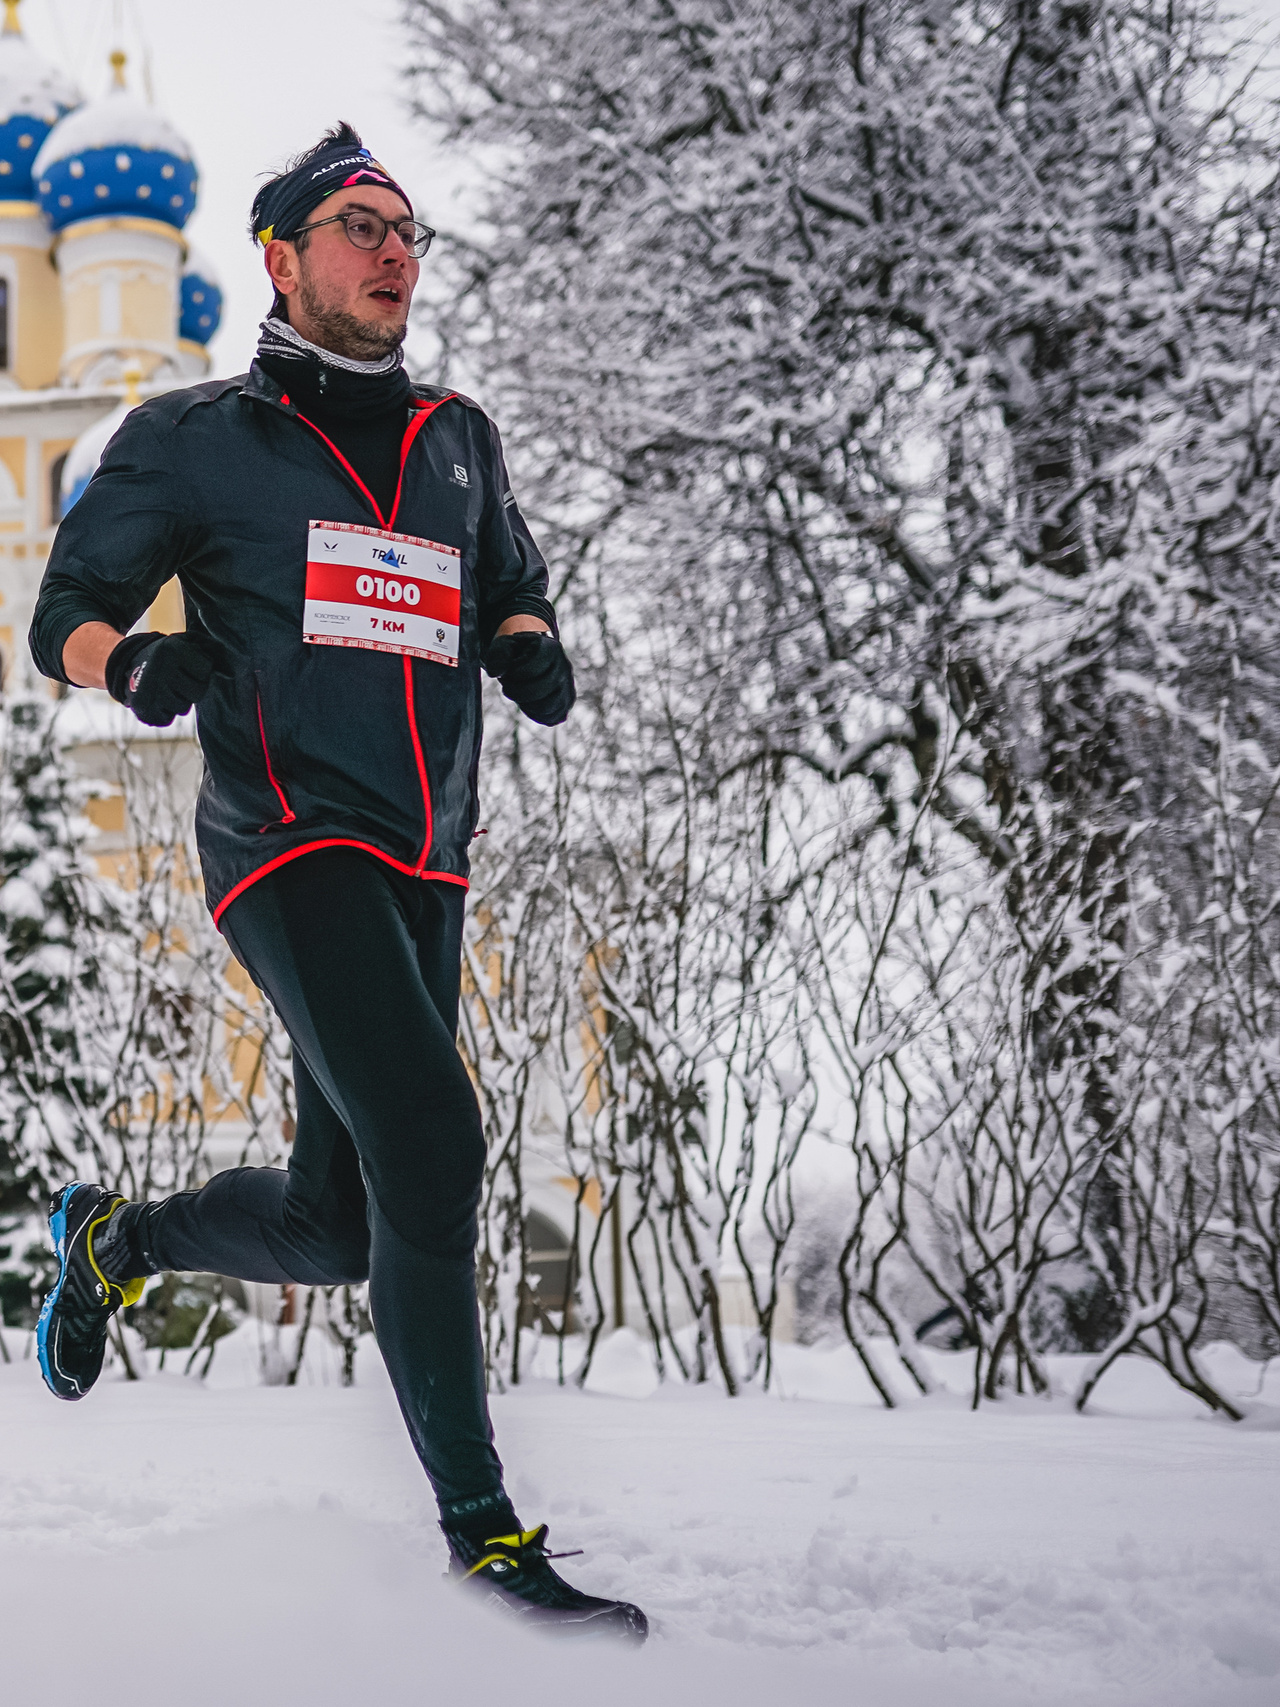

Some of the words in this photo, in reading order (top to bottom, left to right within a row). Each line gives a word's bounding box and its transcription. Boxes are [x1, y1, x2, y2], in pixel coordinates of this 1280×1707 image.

[372, 547, 408, 569] TRAIL
[355, 574, 421, 606] 0100
[370, 617, 379, 629] 7
[382, 619, 405, 634] KM
